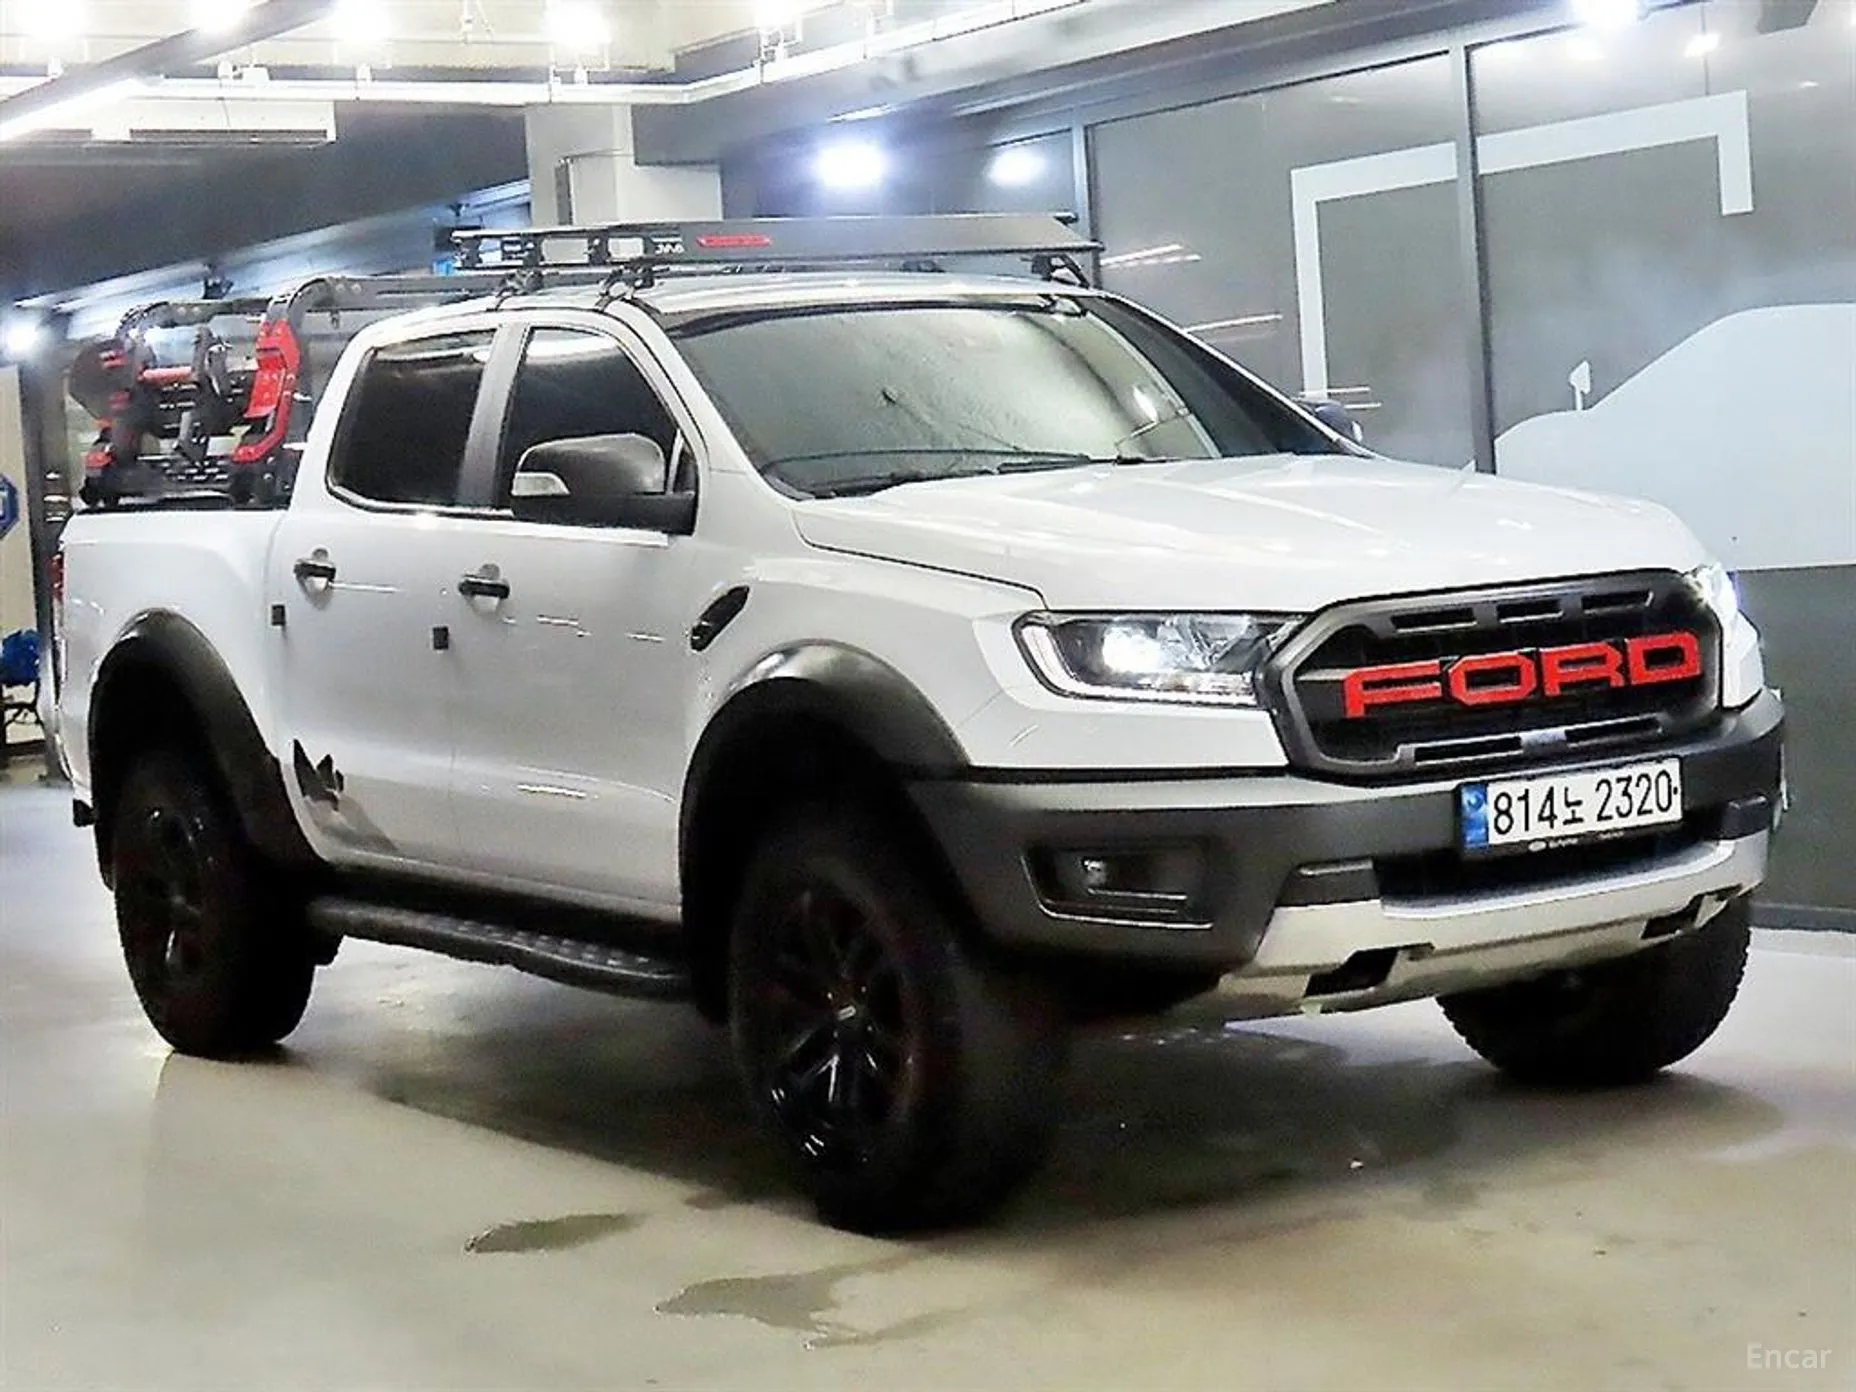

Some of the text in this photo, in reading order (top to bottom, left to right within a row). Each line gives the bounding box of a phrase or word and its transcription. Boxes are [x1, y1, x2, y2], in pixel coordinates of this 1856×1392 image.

[1344, 630, 1702, 719] FORD
[1493, 769, 1673, 835] 814노 2320
